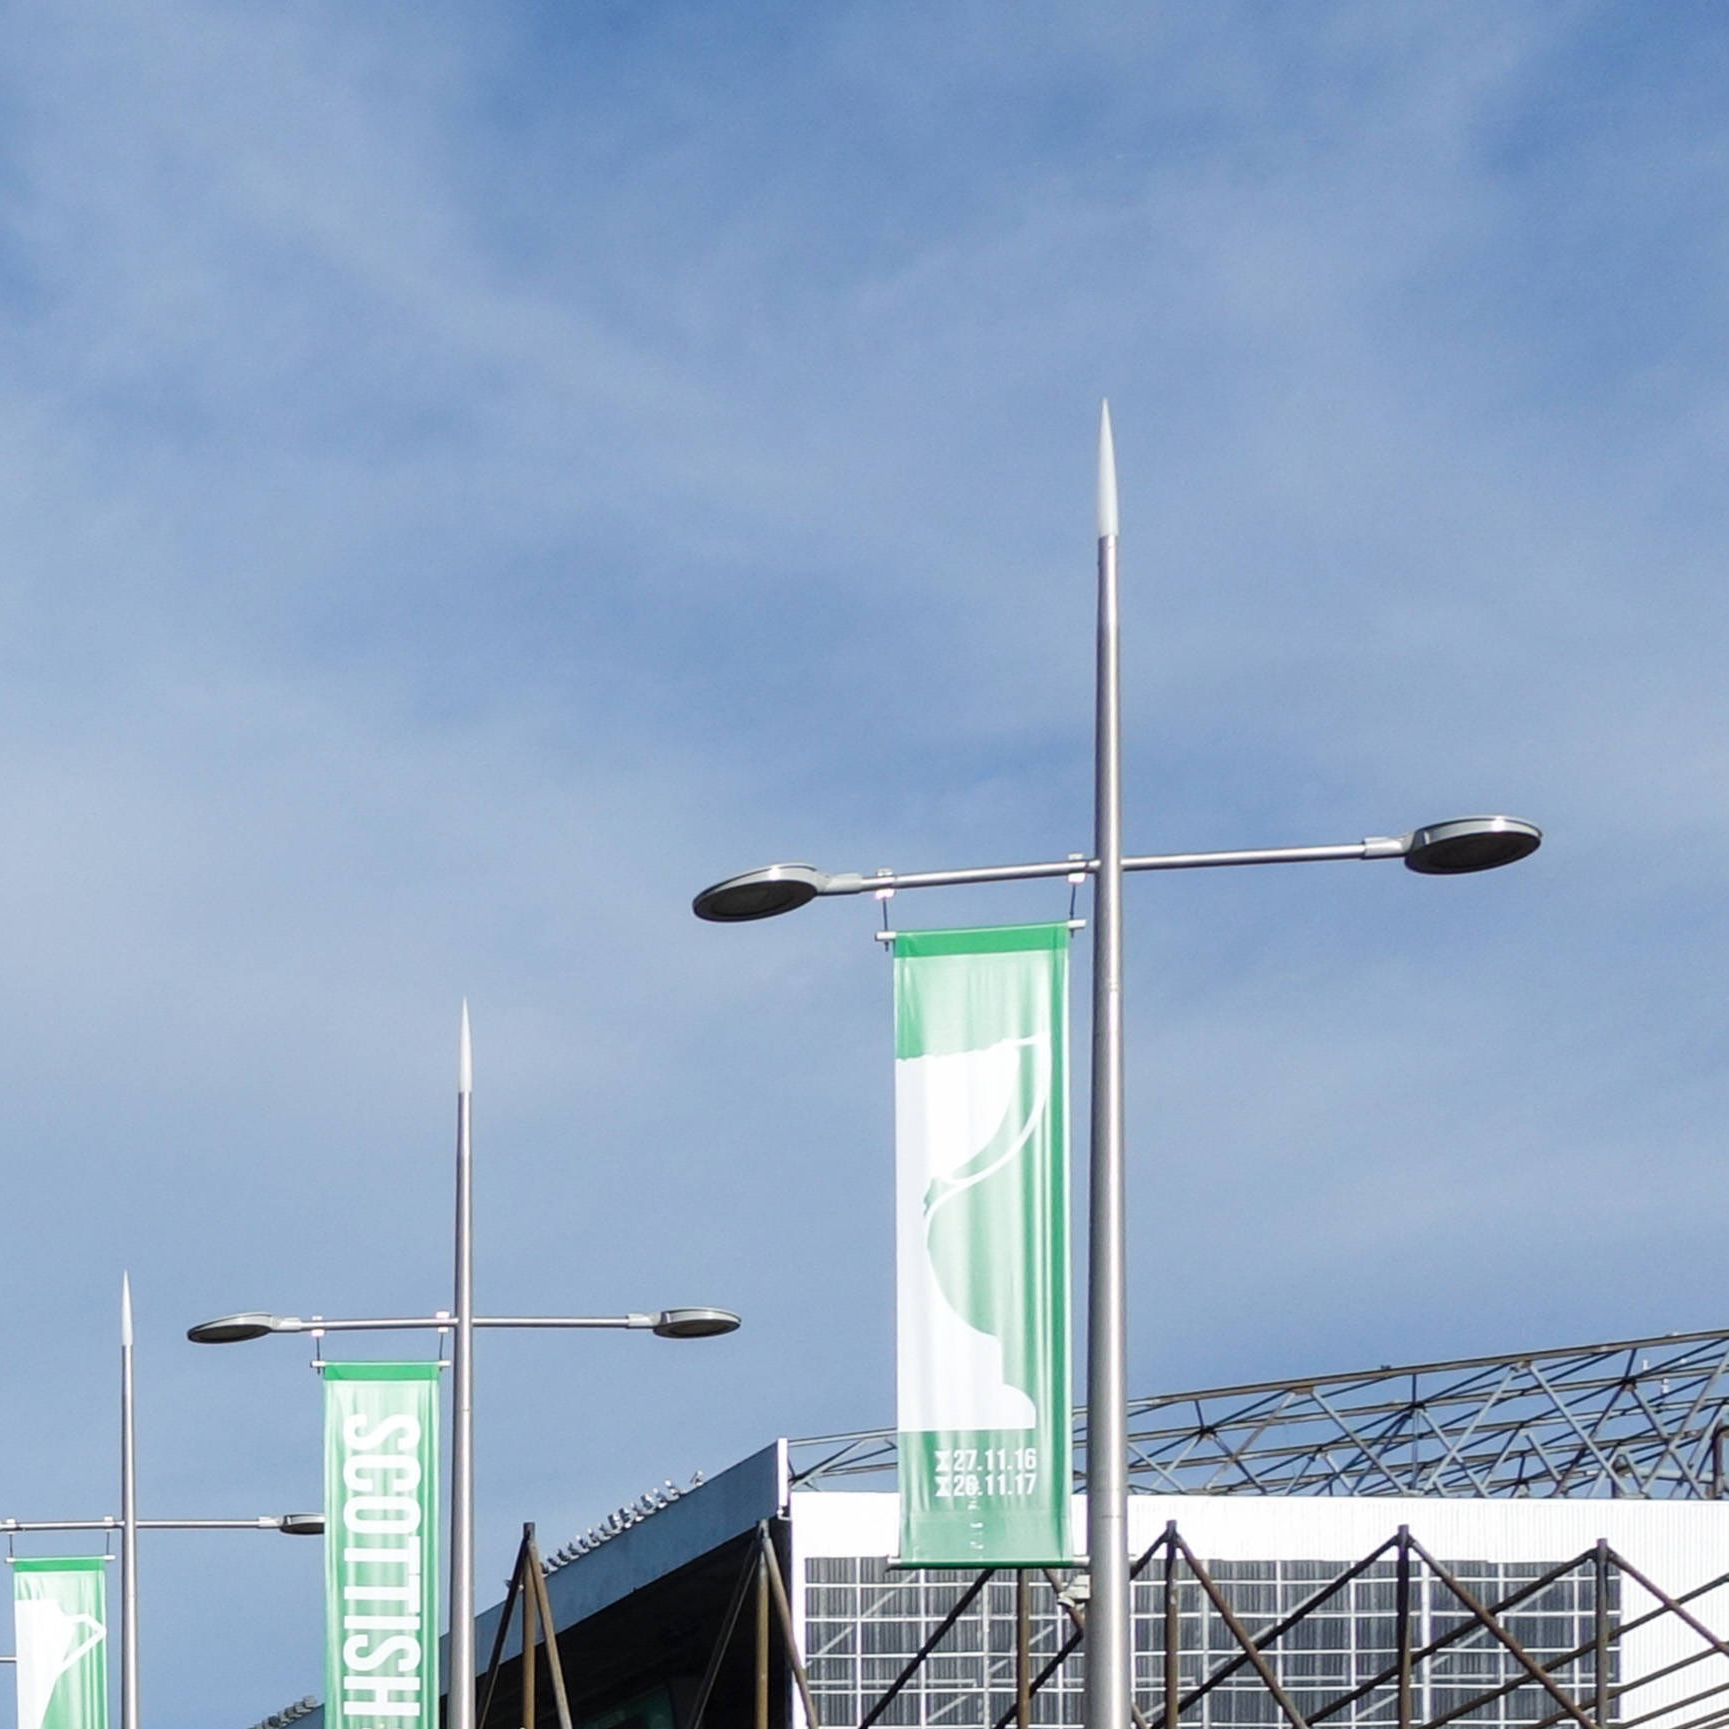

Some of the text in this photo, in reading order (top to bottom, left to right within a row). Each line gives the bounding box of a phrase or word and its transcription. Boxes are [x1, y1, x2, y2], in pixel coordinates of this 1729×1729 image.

[953, 1448, 1037, 1471] 27.11.16
[953, 1473, 1037, 1497] 26.11.17
[343, 1413, 421, 1716] SCOTTISH
